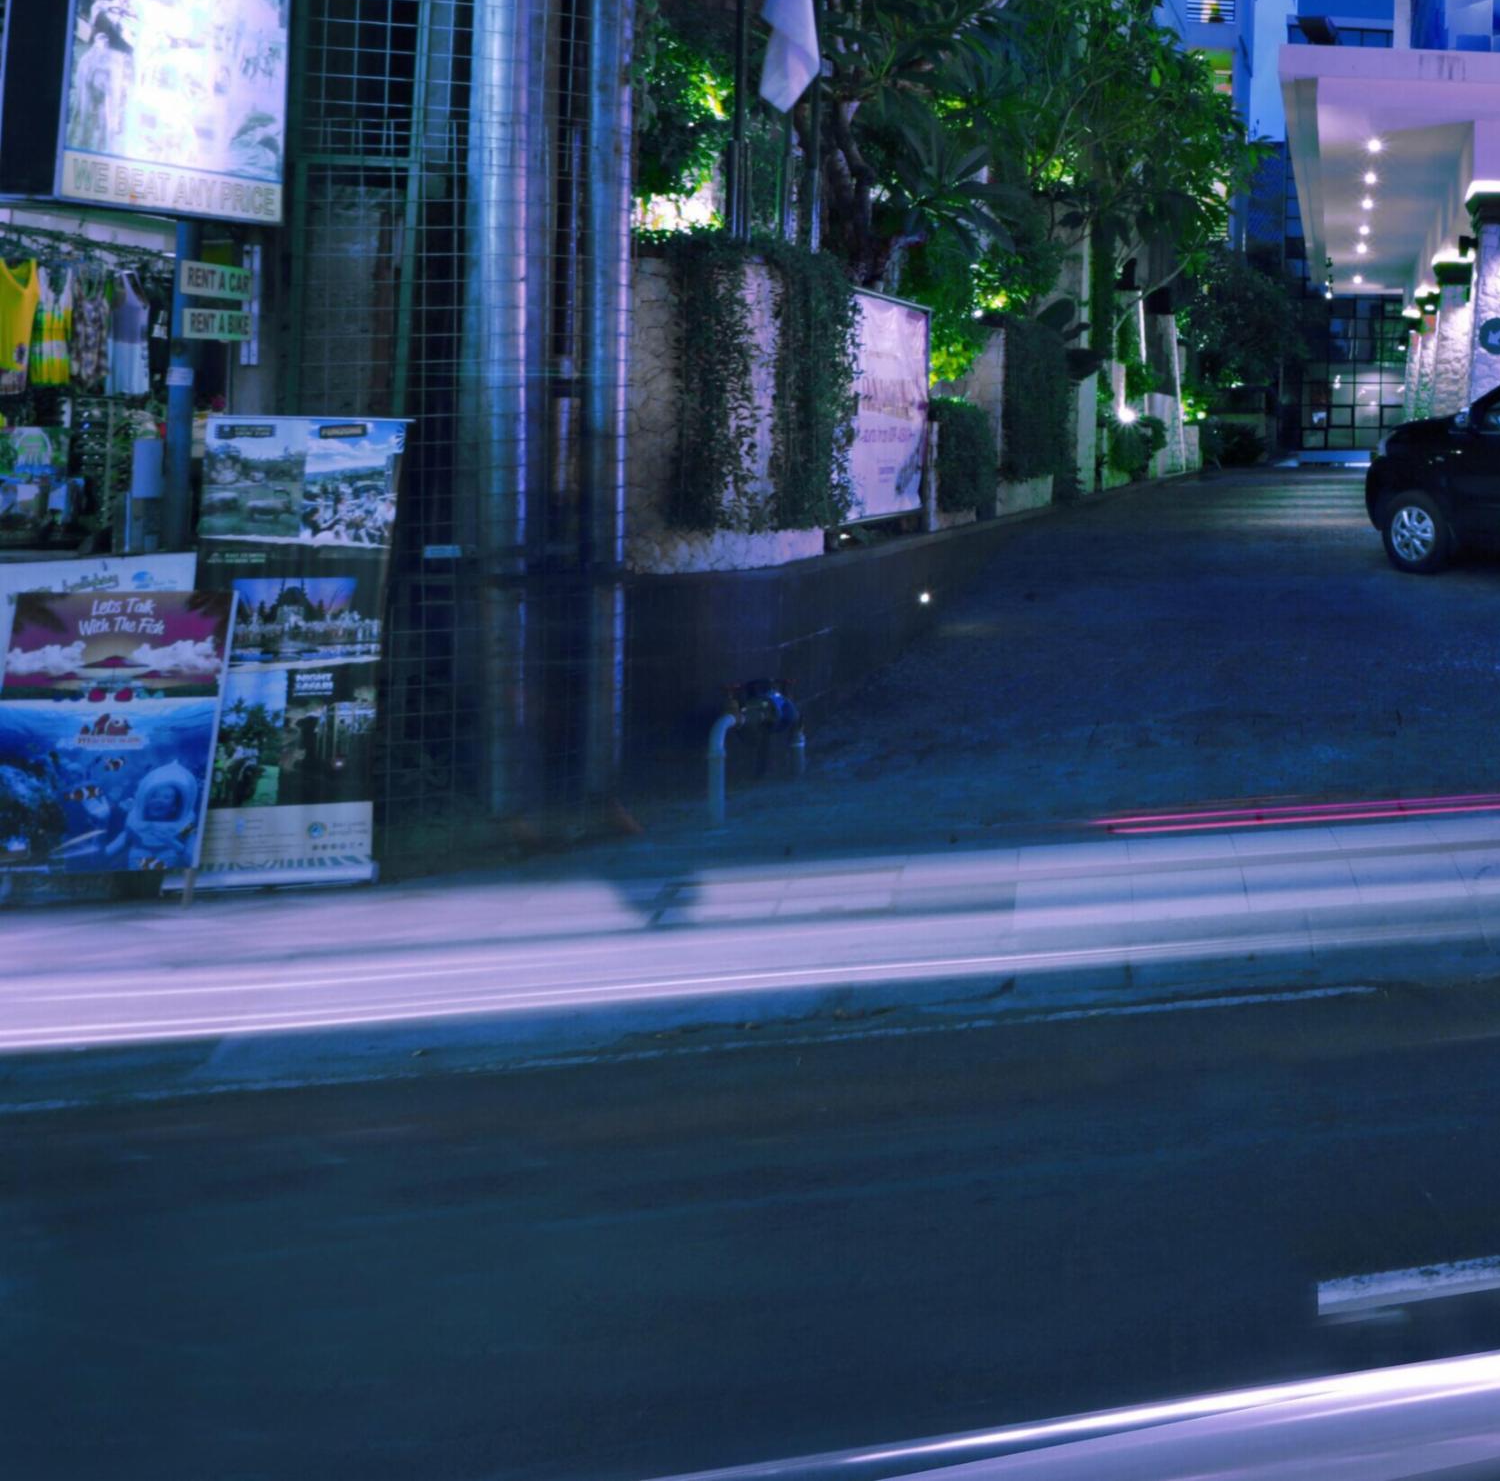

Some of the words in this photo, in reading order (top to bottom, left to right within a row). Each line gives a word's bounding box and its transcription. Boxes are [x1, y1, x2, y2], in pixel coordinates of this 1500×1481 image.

[73, 158, 109, 195] WE
[114, 165, 170, 203] BEAT
[173, 174, 217, 210] ANY
[220, 181, 276, 217] PRICE
[187, 265, 216, 291] RENT
[218, 269, 226, 292] A
[229, 272, 250, 295] CAR
[190, 312, 216, 334] RENT
[218, 313, 226, 335] A
[228, 313, 250, 336] BIKE
[126, 597, 157, 616] Talk
[79, 618, 110, 636] With
[114, 615, 137, 633] The
[138, 617, 166, 636] Fish
